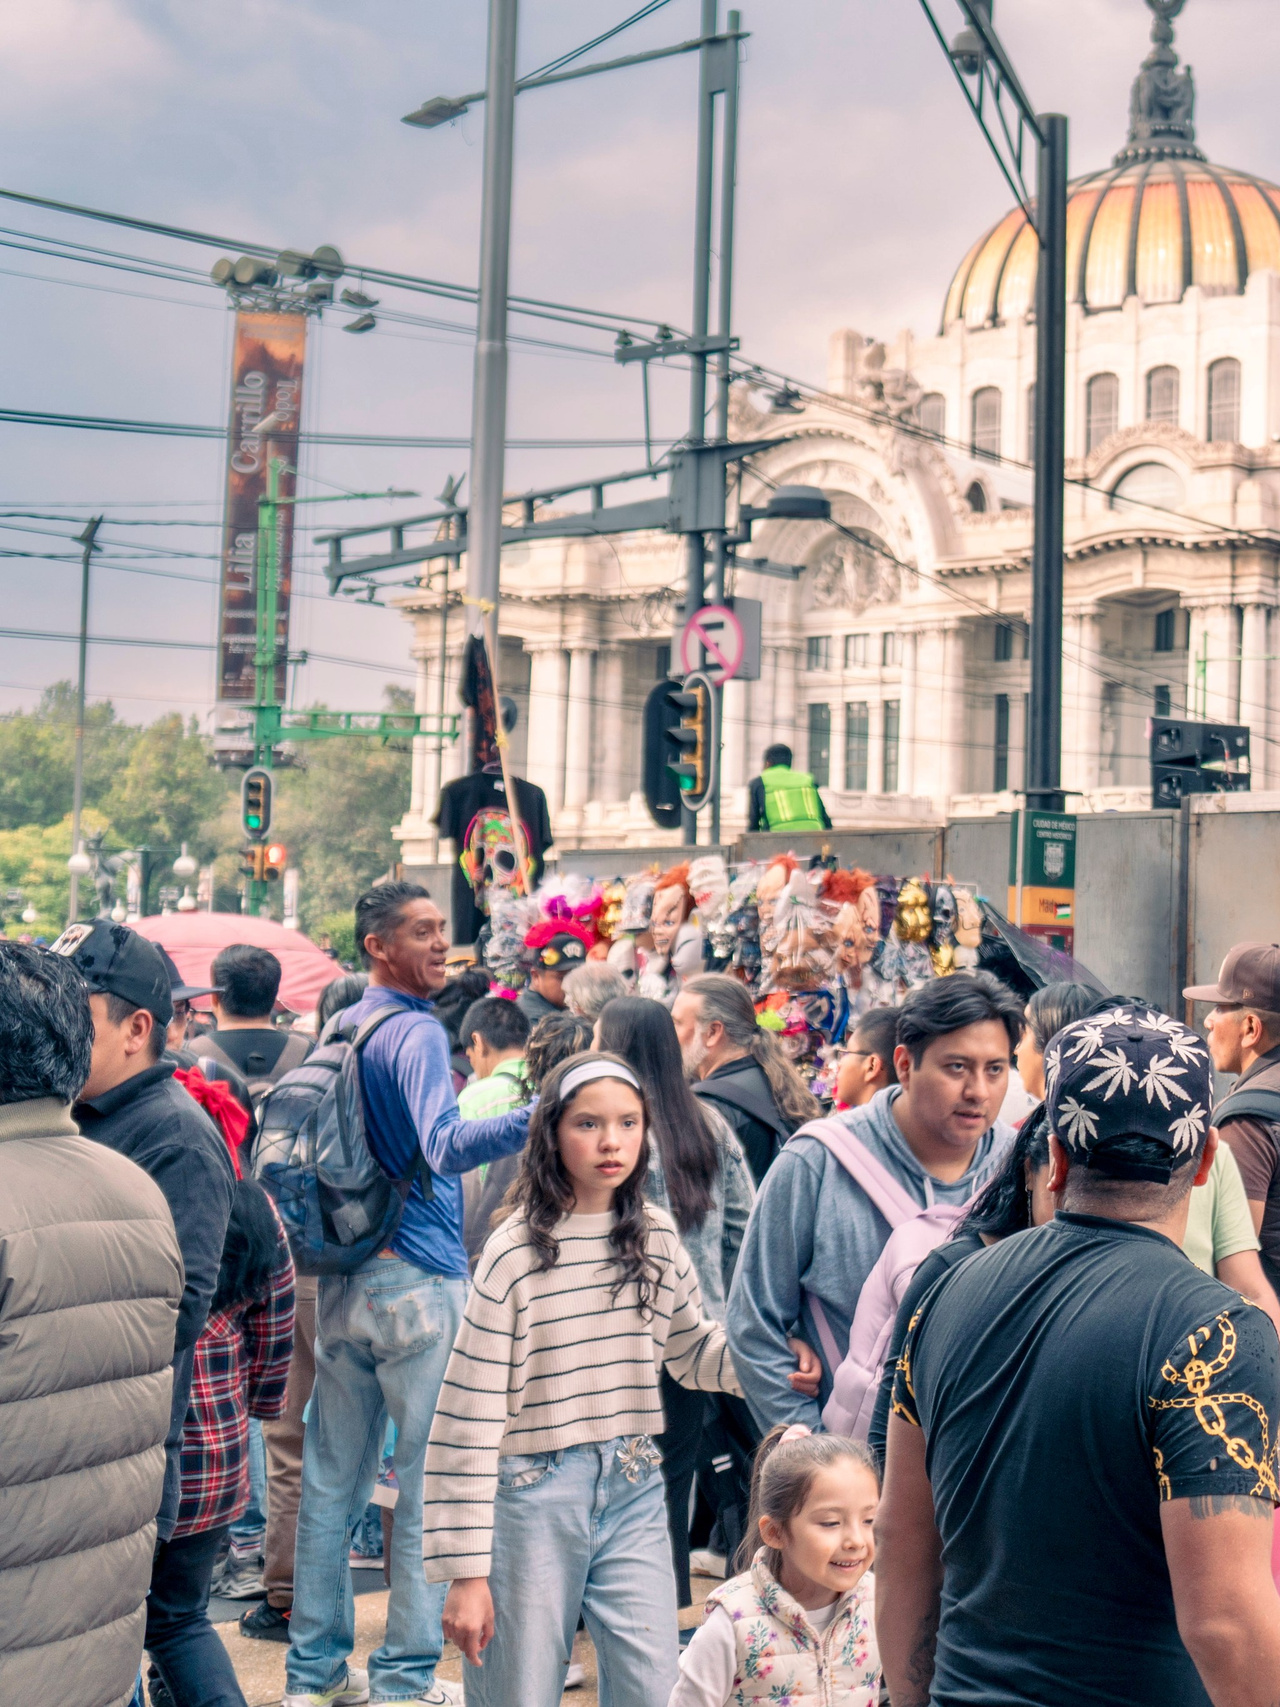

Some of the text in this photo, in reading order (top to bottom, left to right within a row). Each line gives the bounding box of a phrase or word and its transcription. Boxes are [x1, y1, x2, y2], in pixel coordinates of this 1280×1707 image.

[276, 380, 297, 421] Todo
[225, 371, 263, 594] Lilia Carrillo
[1033, 819, 1050, 829] CIUDAD
[1051, 821, 1058, 829] DE
